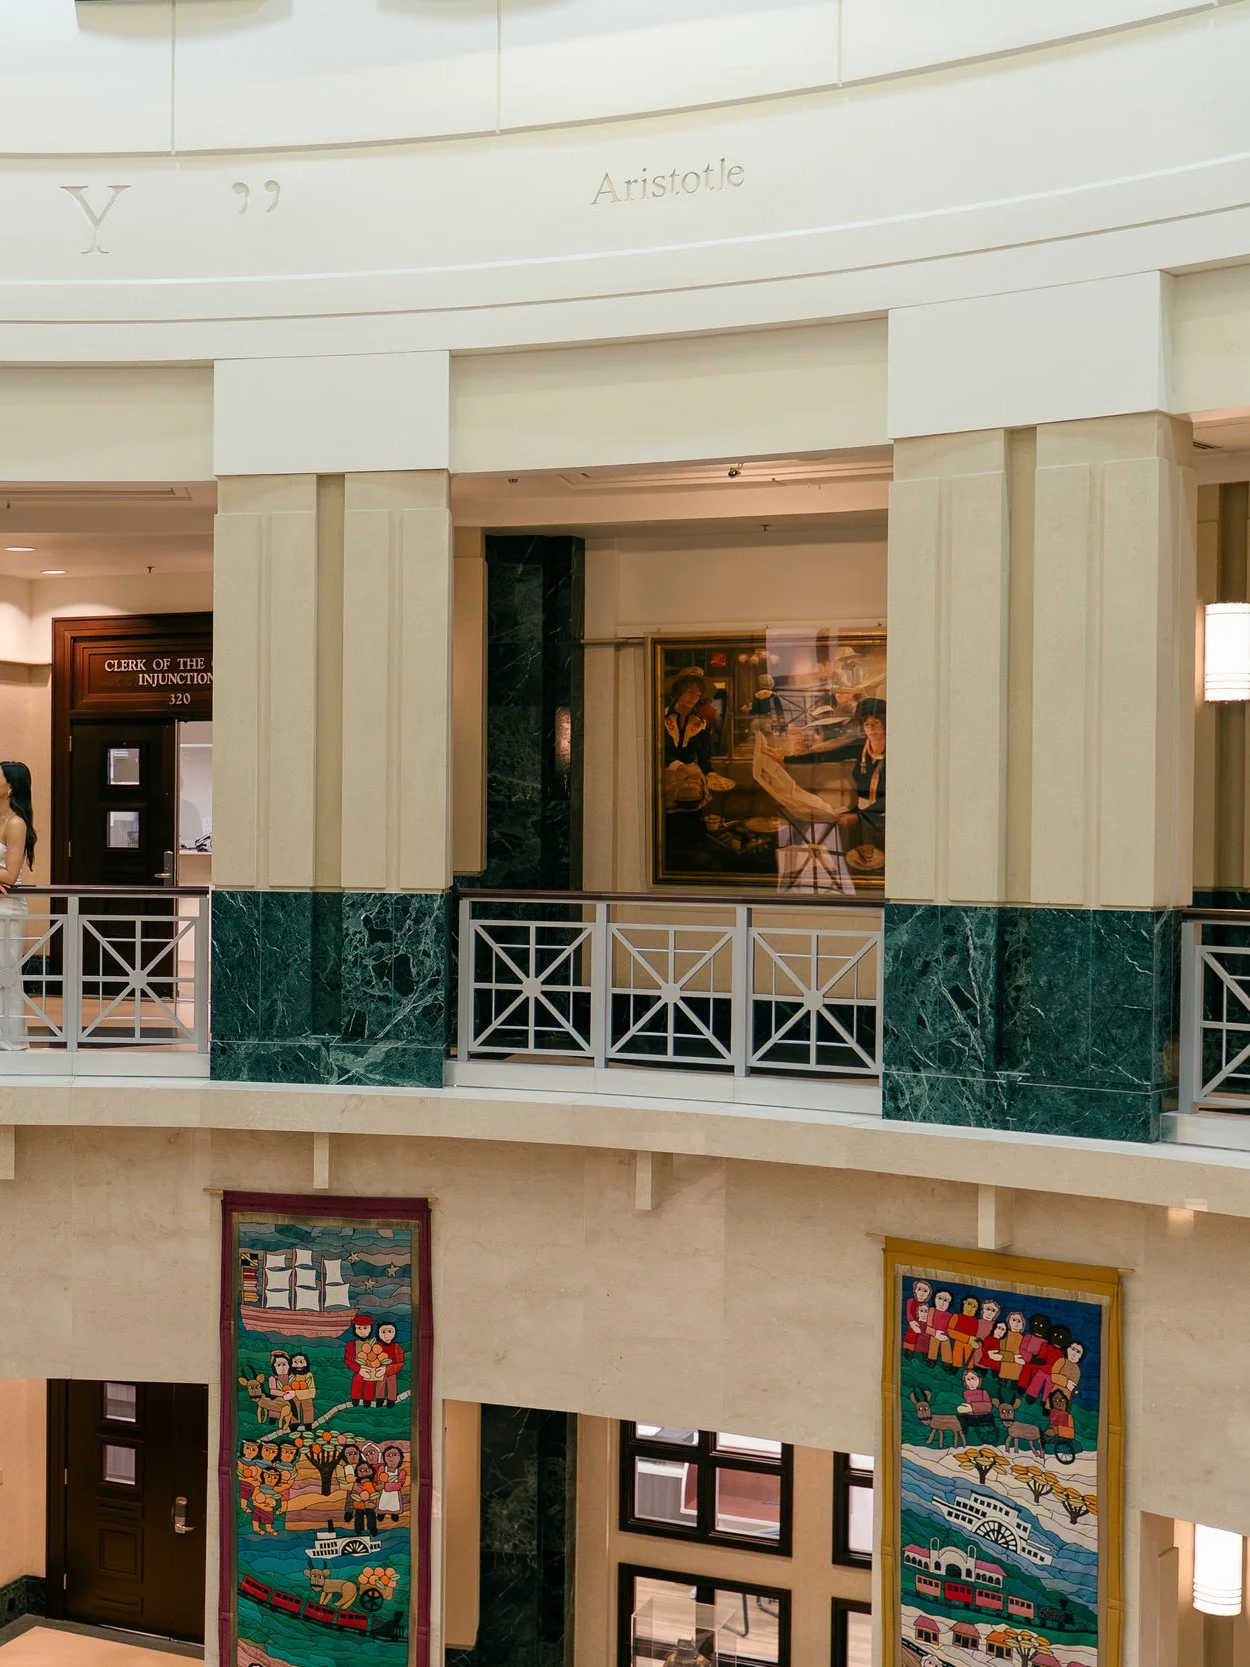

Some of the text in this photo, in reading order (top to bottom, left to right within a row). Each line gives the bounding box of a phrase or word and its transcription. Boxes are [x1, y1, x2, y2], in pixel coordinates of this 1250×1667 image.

[590, 157, 745, 205] Aristotle
[105, 657, 205, 672] CLERK OF THE
[169, 693, 190, 705] 320
